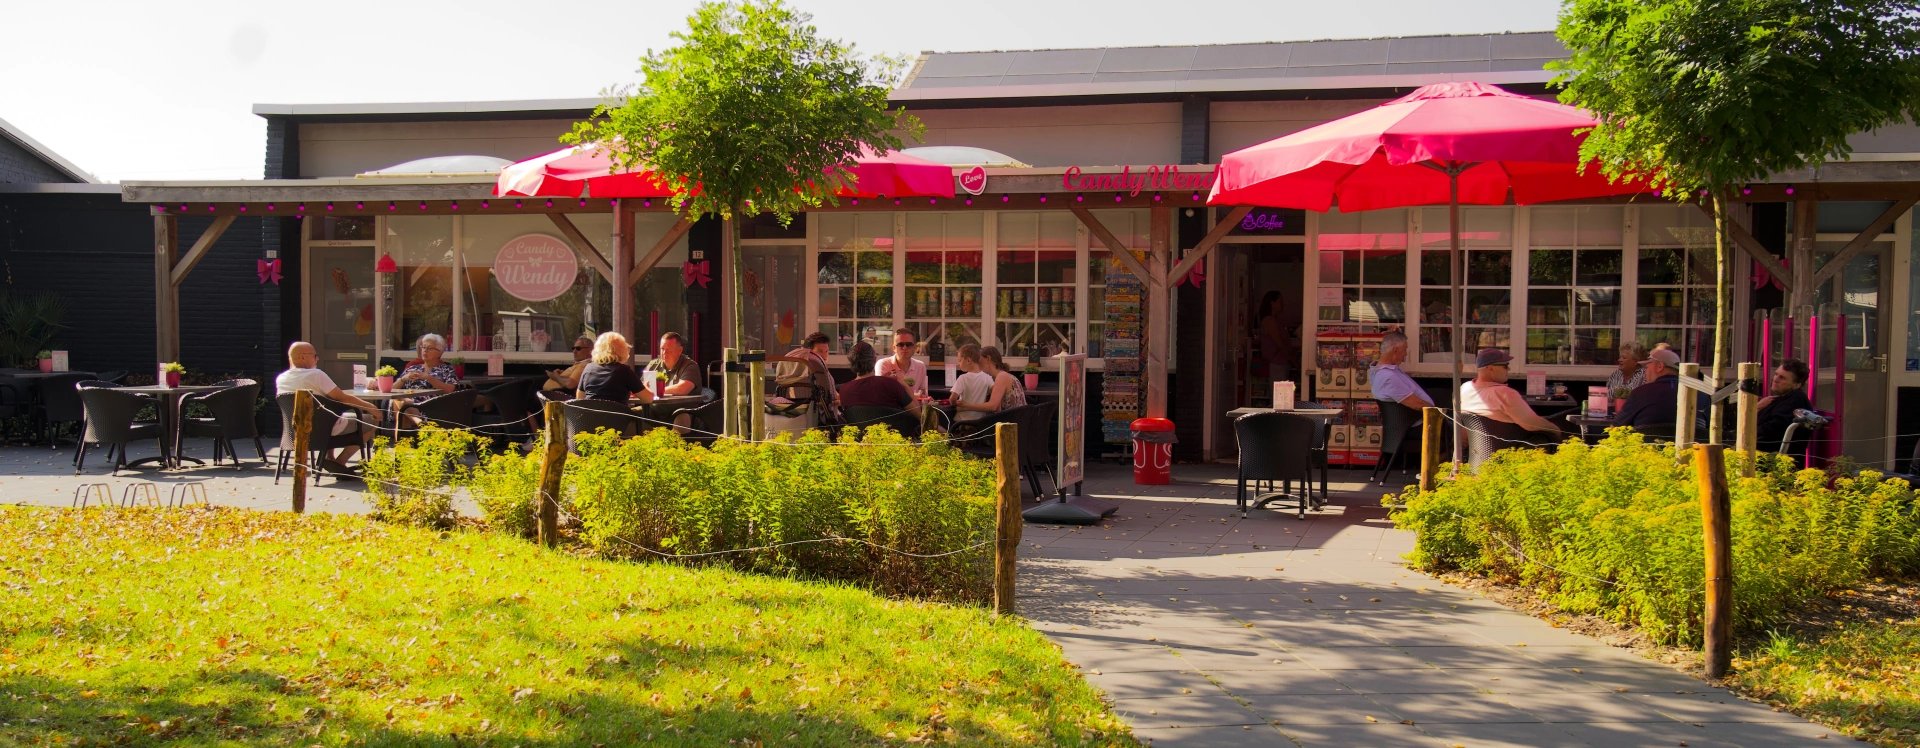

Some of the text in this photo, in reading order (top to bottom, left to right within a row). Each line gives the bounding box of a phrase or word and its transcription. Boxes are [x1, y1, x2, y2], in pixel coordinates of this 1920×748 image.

[965, 173, 983, 185] Love
[1147, 164, 1220, 190] Wend
[1256, 213, 1284, 231] Coffee
[516, 241, 555, 258] Candy
[502, 264, 567, 291] Wendy
